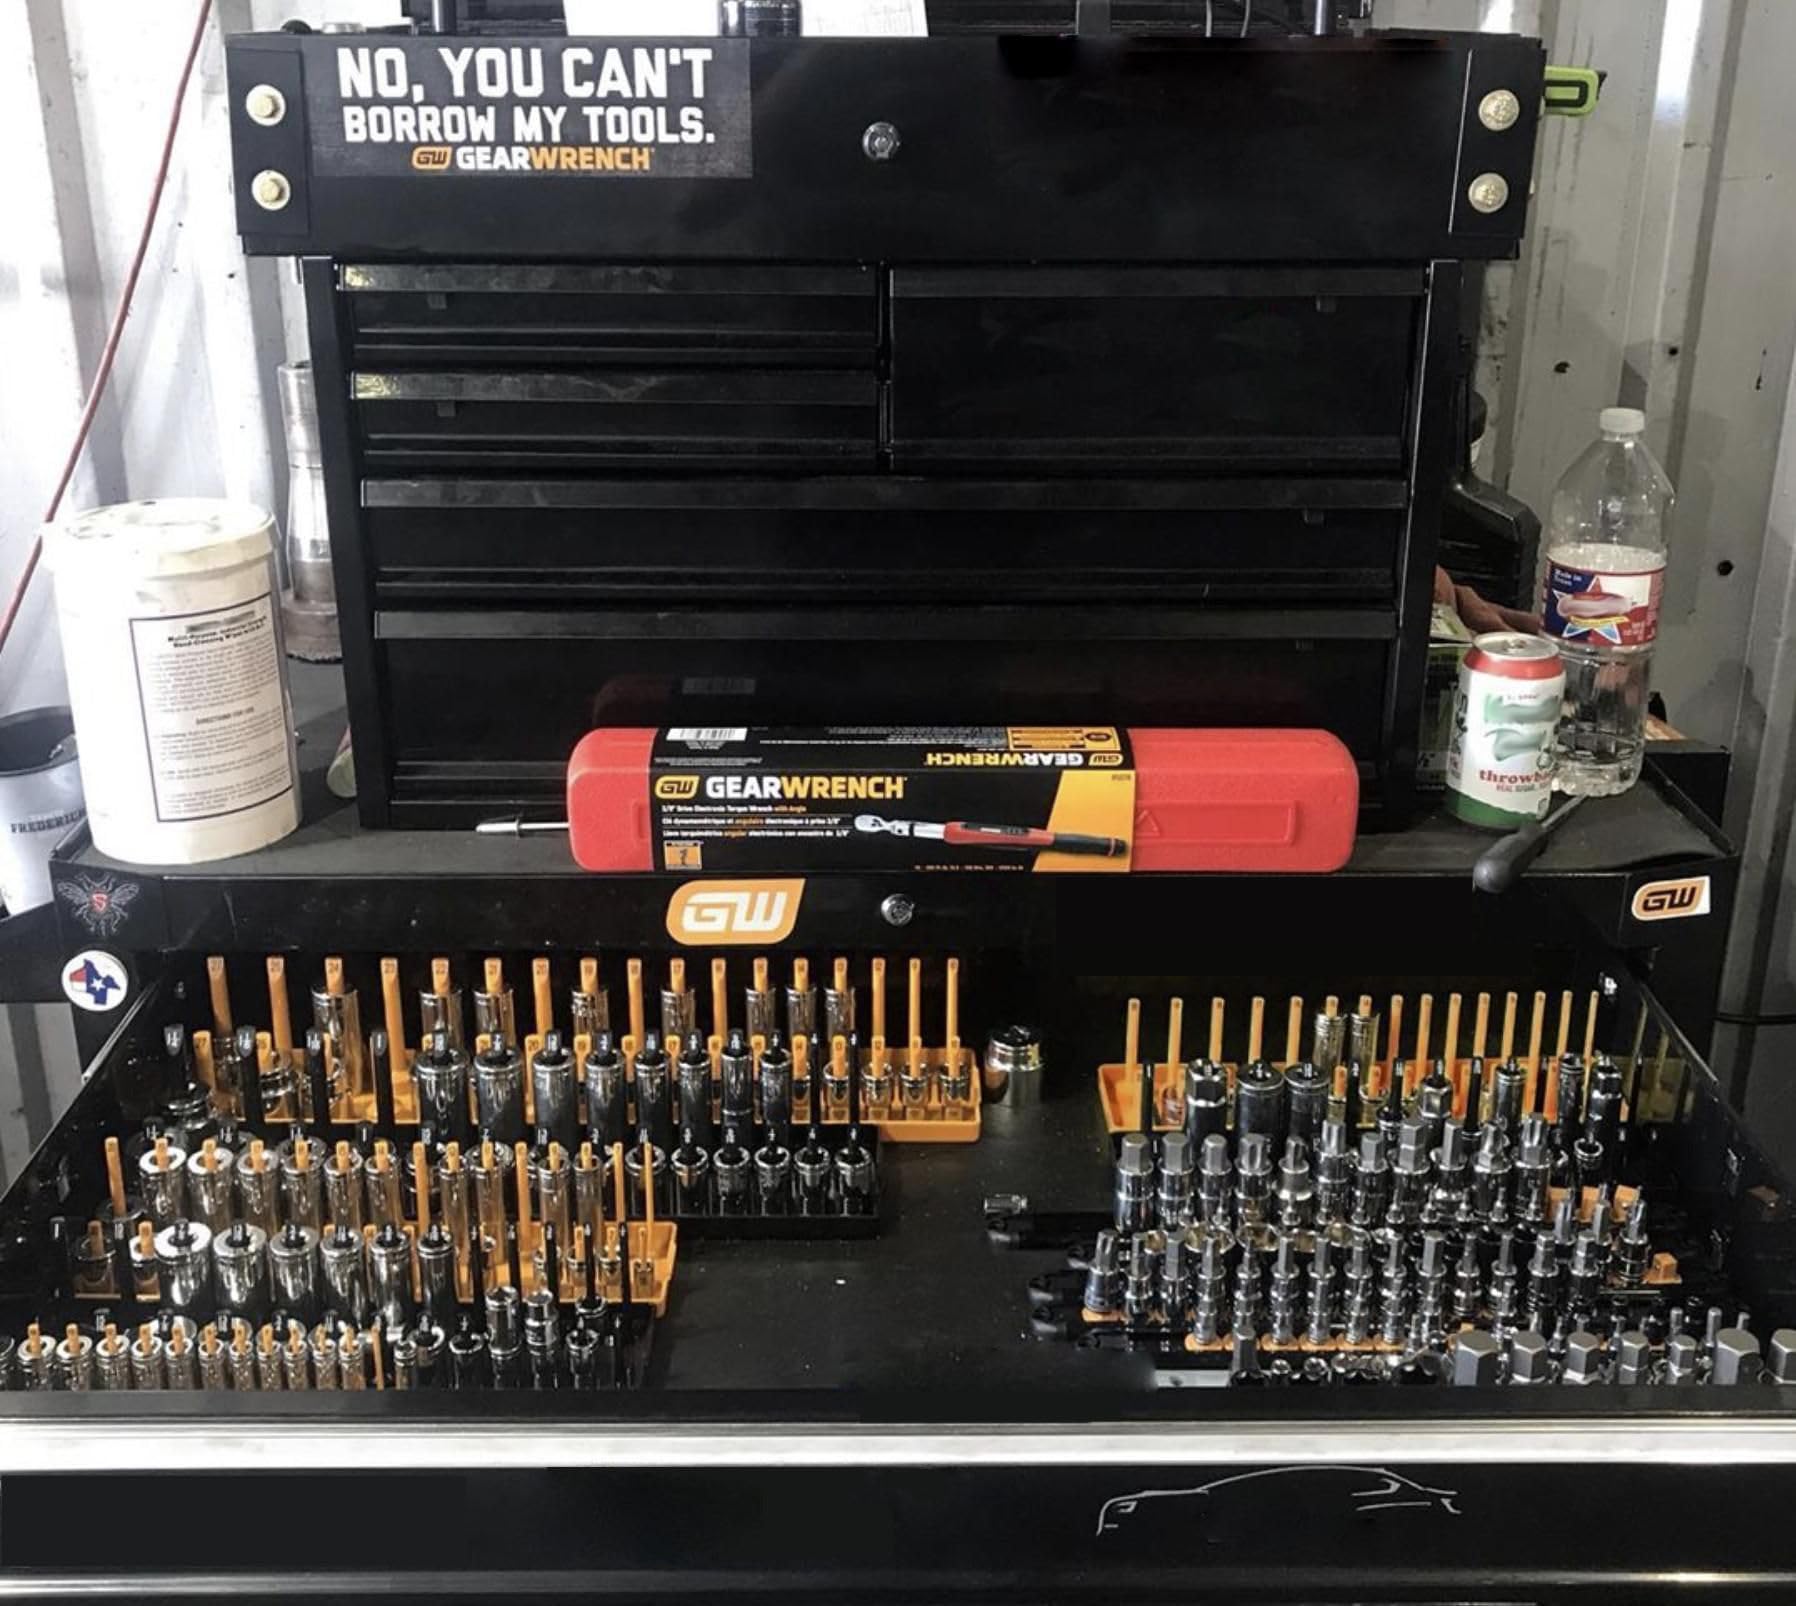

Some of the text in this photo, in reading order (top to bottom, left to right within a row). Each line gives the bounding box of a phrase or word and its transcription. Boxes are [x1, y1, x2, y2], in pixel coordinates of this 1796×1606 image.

[337, 48, 713, 103] NO, YOU CAN'T
[343, 105, 716, 143] BORROW MY TOOLS.
[415, 147, 650, 171] GW GEARWRENCH
[926, 752, 1084, 767] GEARWRENCH
[706, 775, 907, 799] GEARWRENCH
[679, 889, 791, 935] GW
[1641, 885, 1699, 914] GW
